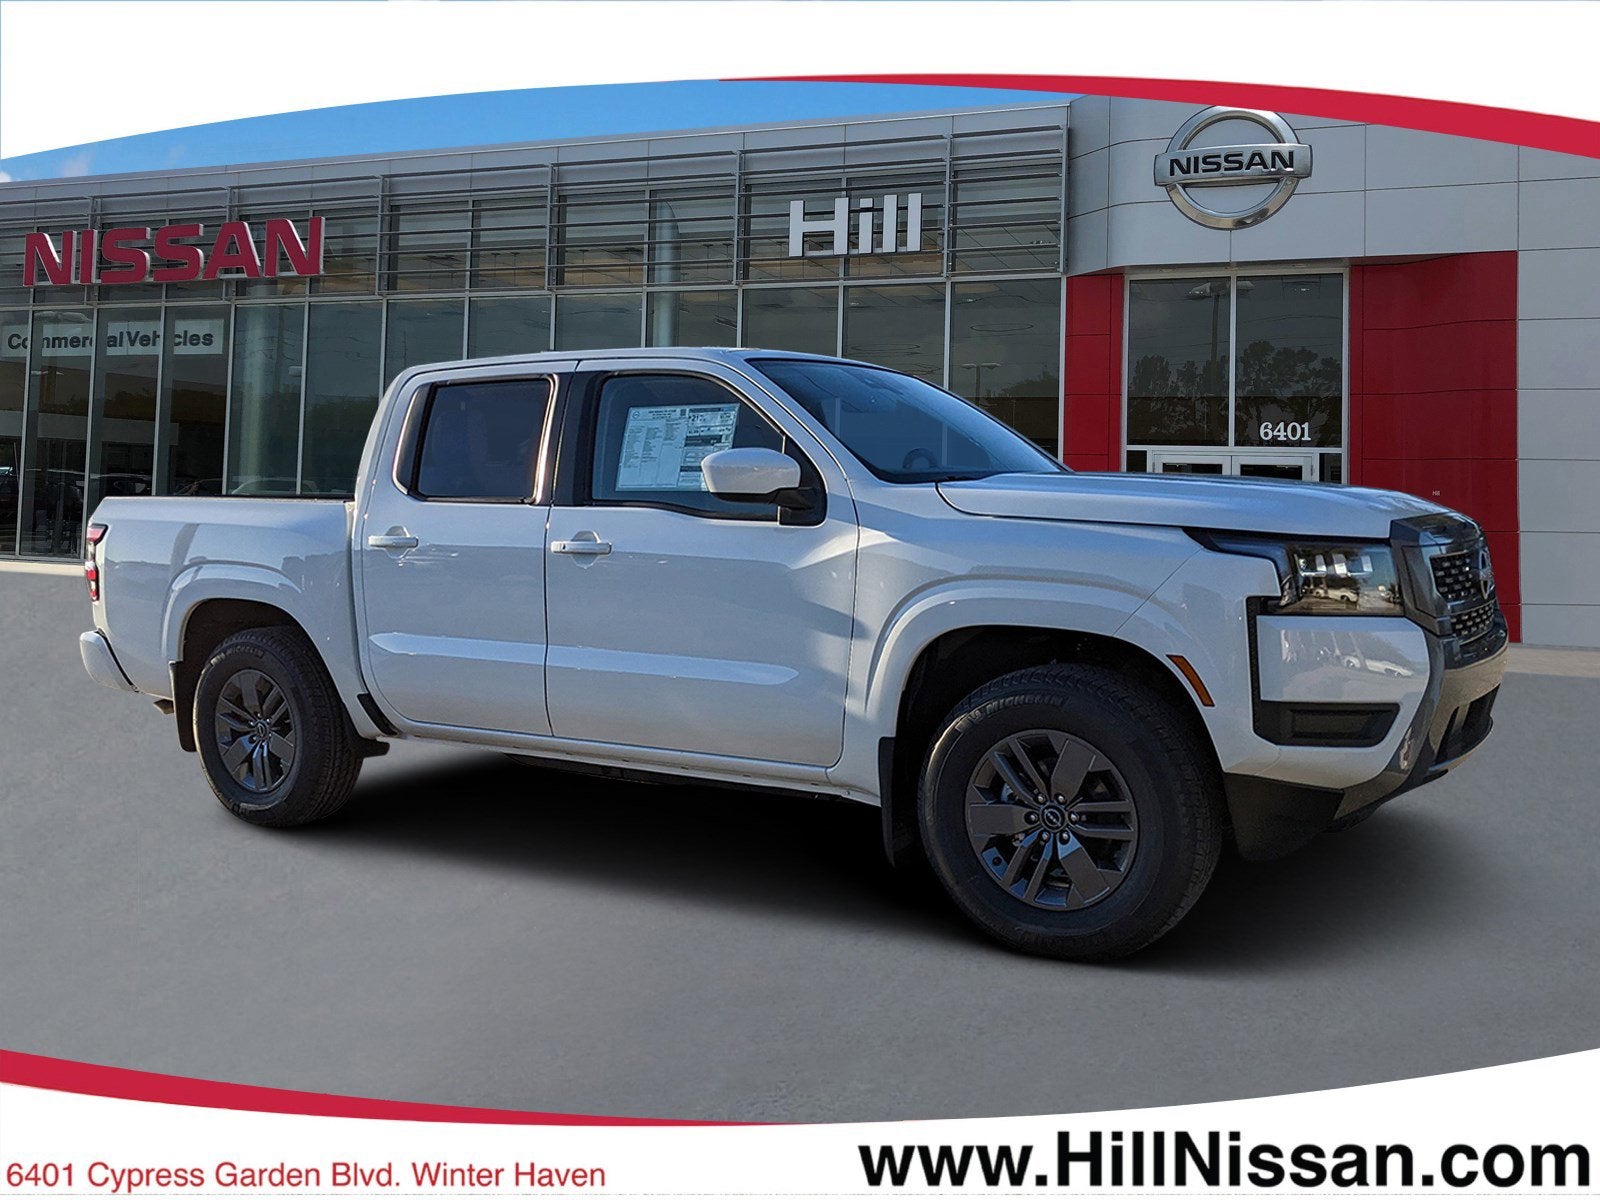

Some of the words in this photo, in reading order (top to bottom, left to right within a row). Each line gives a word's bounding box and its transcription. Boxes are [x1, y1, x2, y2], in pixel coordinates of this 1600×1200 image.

[1169, 149, 1295, 177] NISSAN
[788, 192, 922, 257] Hill
[23, 216, 325, 287] NISSAN
[8, 330, 124, 350] Comeral
[126, 329, 214, 347] Vehcles
[1259, 421, 1312, 441] 6401
